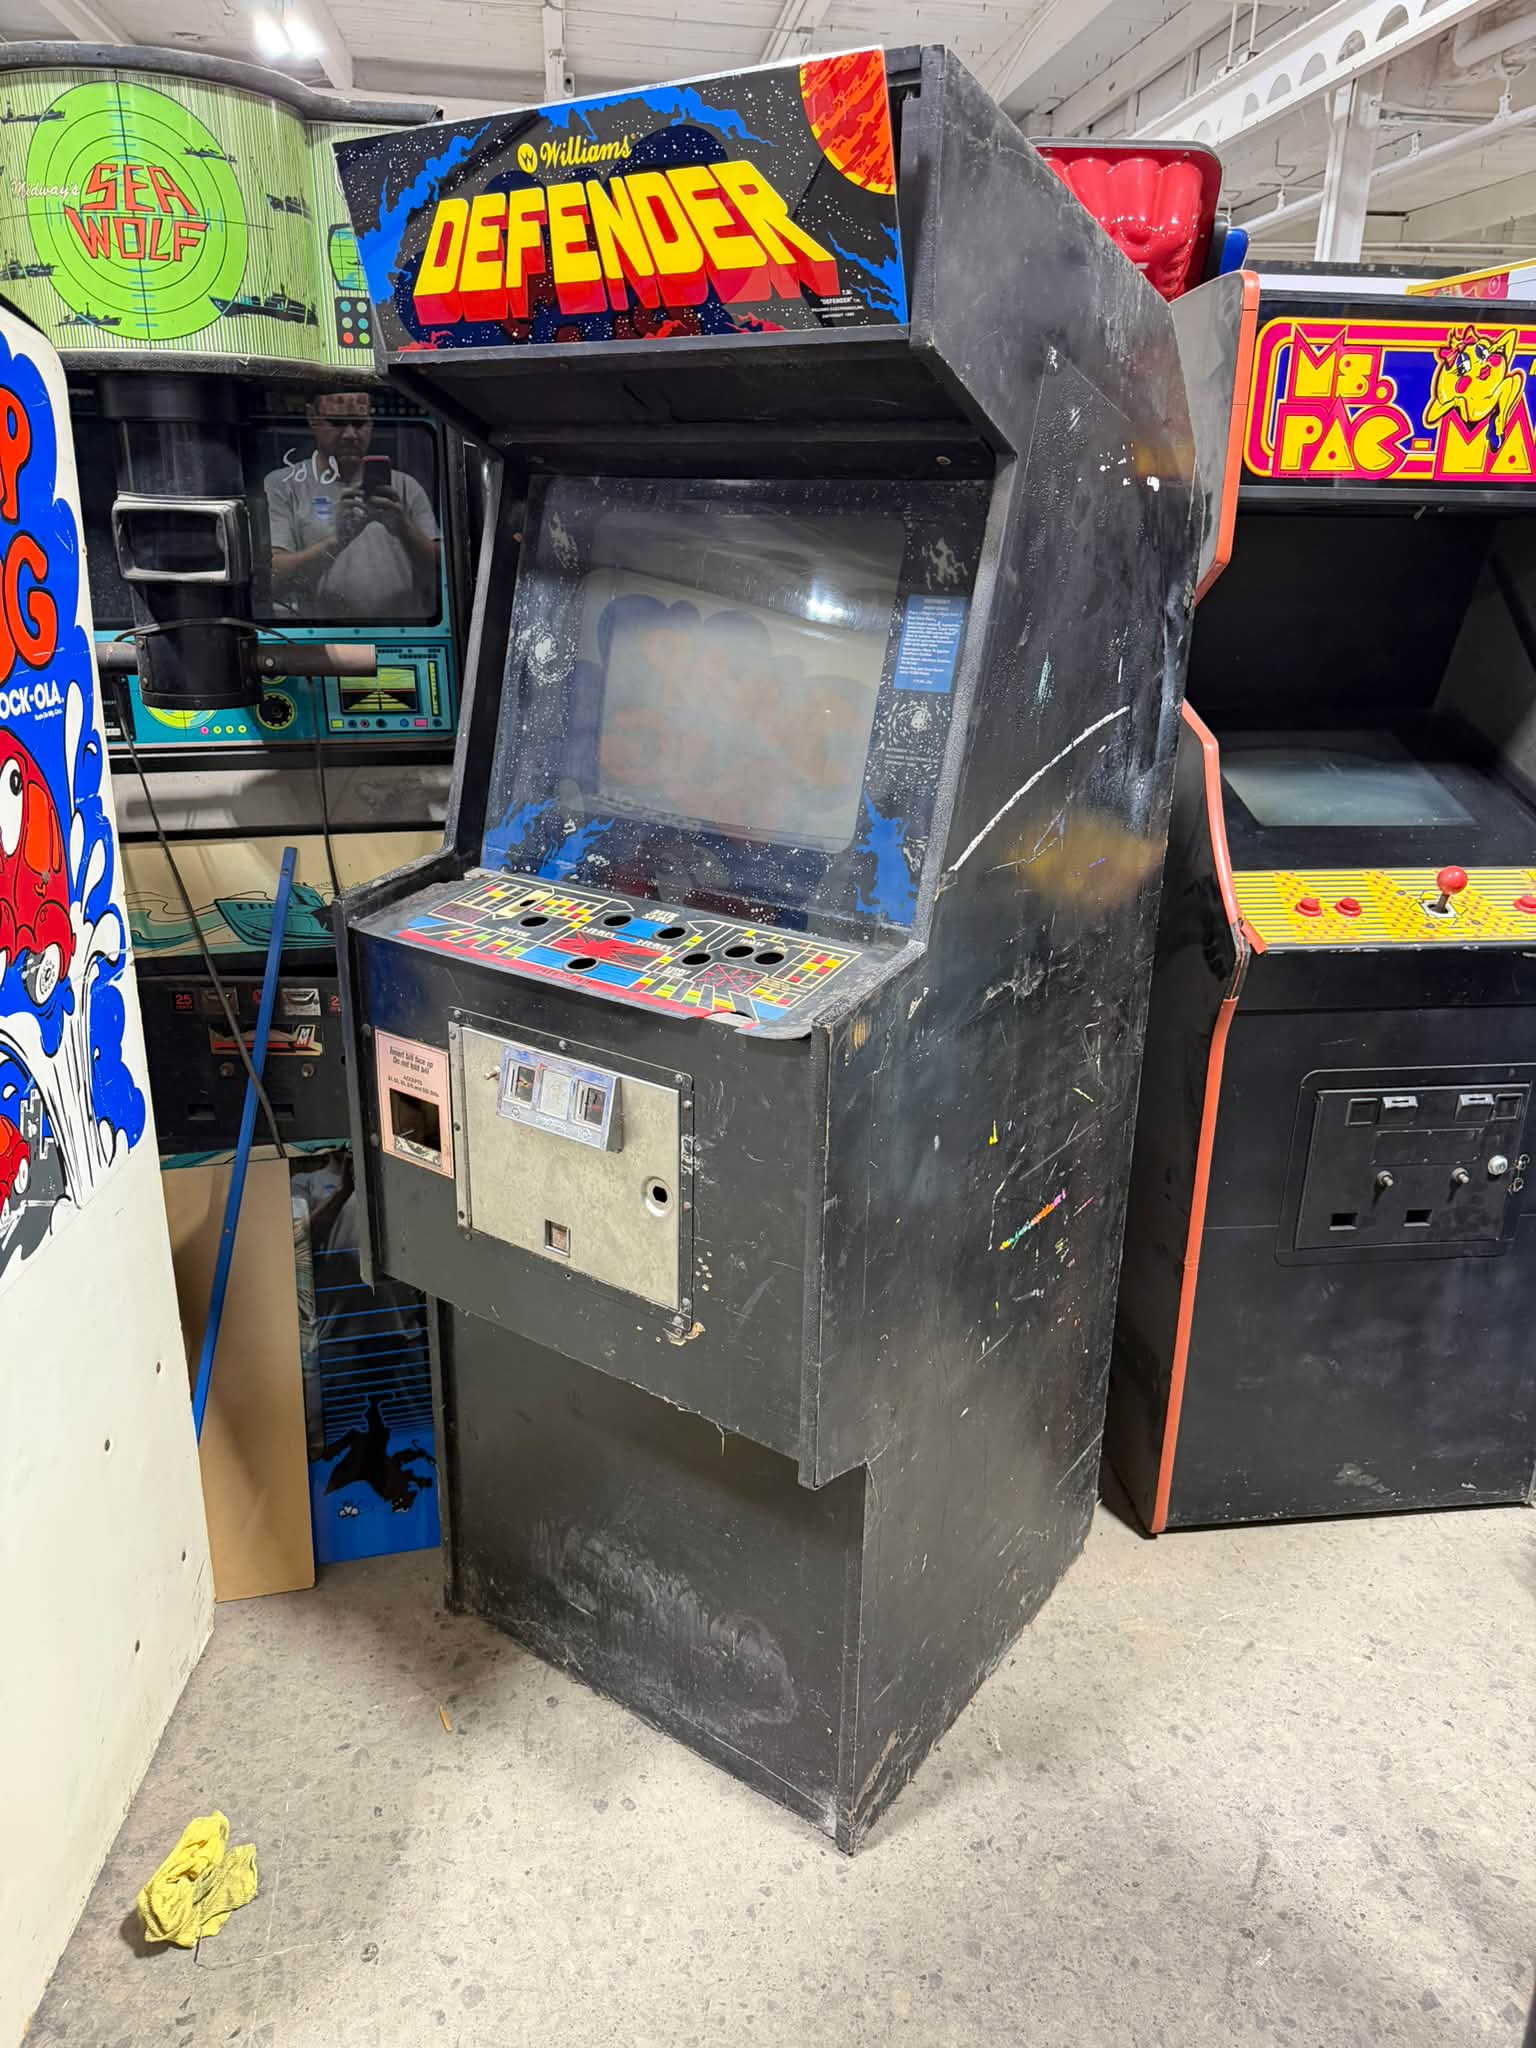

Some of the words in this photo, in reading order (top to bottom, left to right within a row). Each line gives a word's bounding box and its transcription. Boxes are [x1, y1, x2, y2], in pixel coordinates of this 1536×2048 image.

[540, 135, 632, 168] Williams
[10, 178, 80, 198] Midway's
[80, 163, 200, 217] SEA
[63, 203, 209, 262] WOLF
[413, 160, 840, 325] DEFENDER
[1288, 323, 1396, 402] Ms.
[1276, 396, 1536, 476] PAC-MA
[282, 448, 340, 484] Sold
[176, 994, 192, 1005] 25
